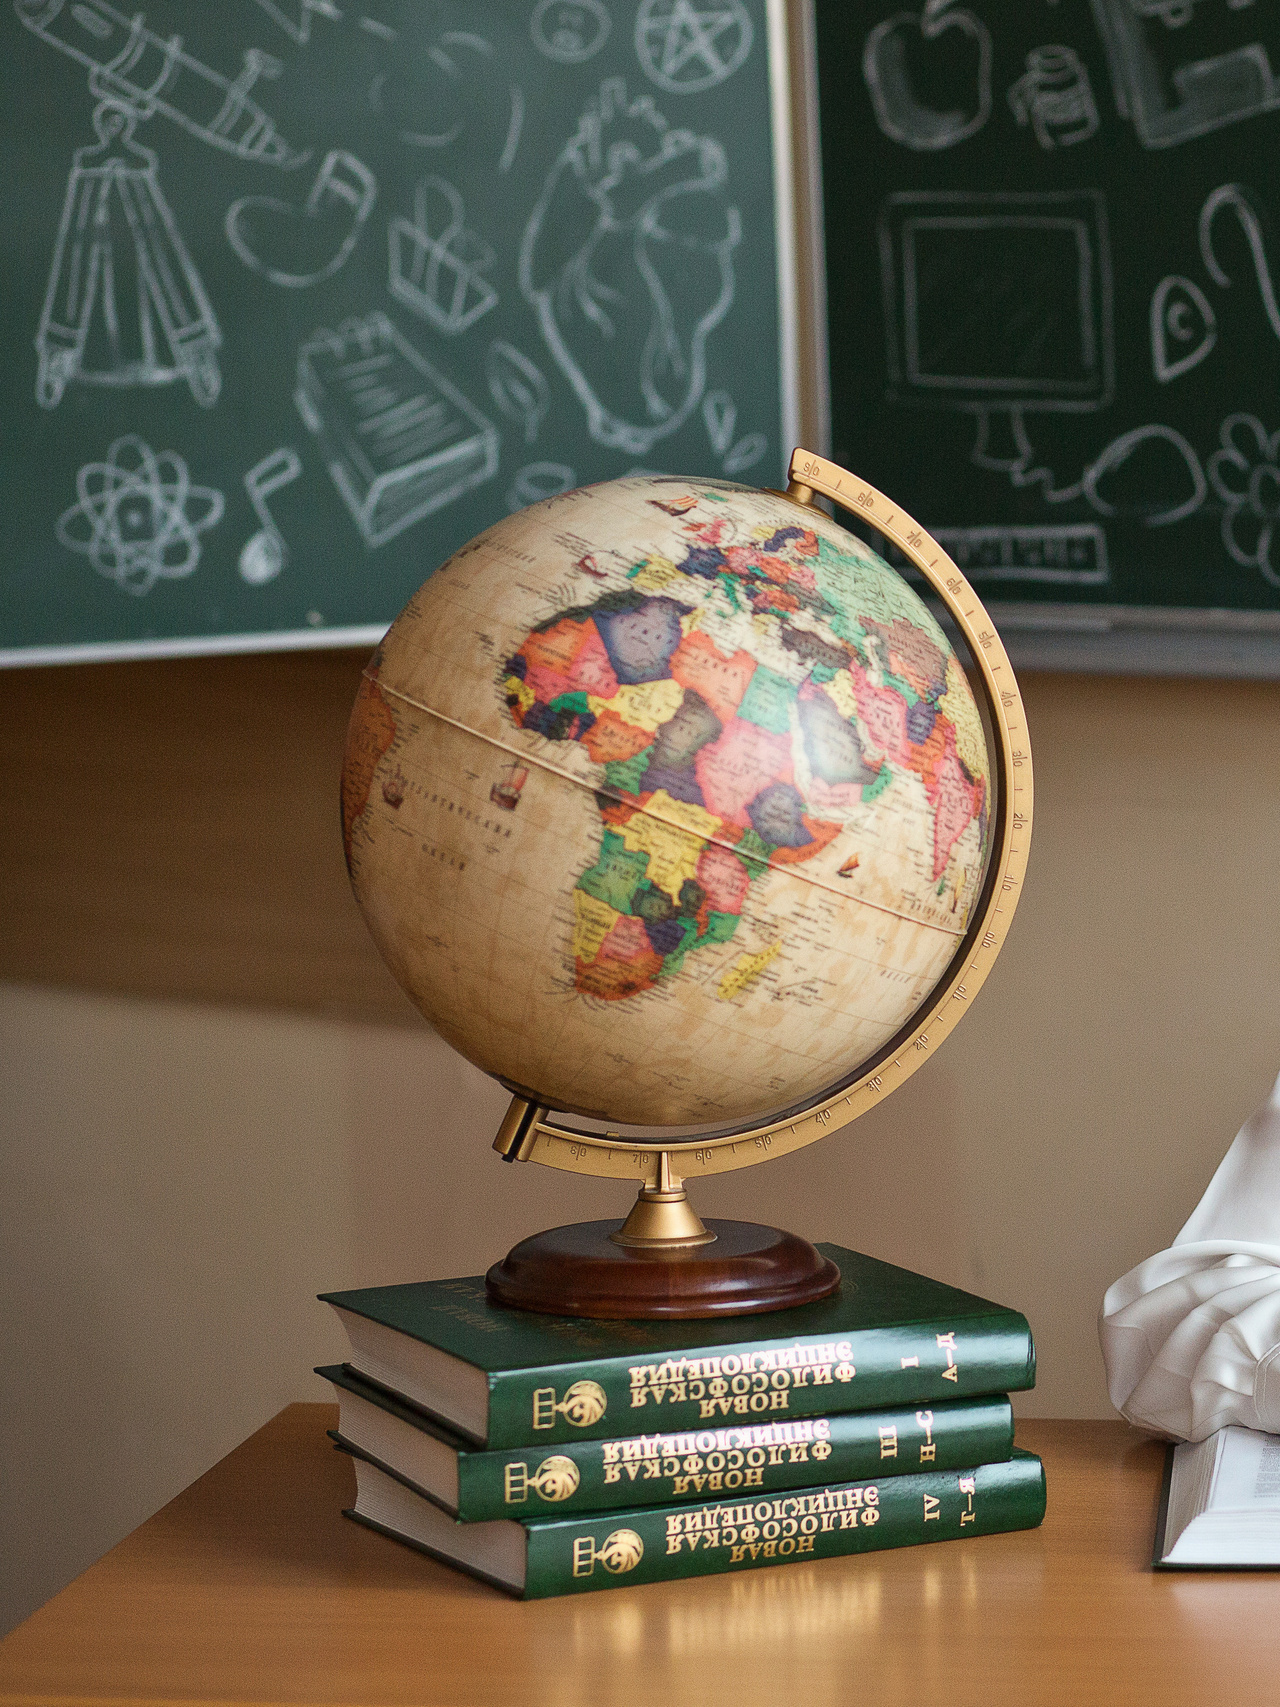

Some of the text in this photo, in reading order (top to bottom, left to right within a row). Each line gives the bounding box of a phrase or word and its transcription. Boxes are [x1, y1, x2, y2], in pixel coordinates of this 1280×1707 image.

[628, 1341, 854, 1388] ЭНЦИКЛОПЕДИЯ
[629, 1361, 856, 1408] ФИЛОСОФСКАЯ
[699, 1389, 790, 1419] НОВАЯ
[601, 1419, 831, 1464] ЭНЦИКЛОПЕДИЯ
[603, 1439, 833, 1484] ФИЛОСОФСКАЯ
[673, 1467, 765, 1495] НОВАЯ
[666, 1486, 880, 1535] ЭНЦИКЛОПЕДИЯ
[666, 1507, 881, 1555] ФИЛОСОФСКАЯ
[729, 1535, 817, 1563] НОВАЯ
